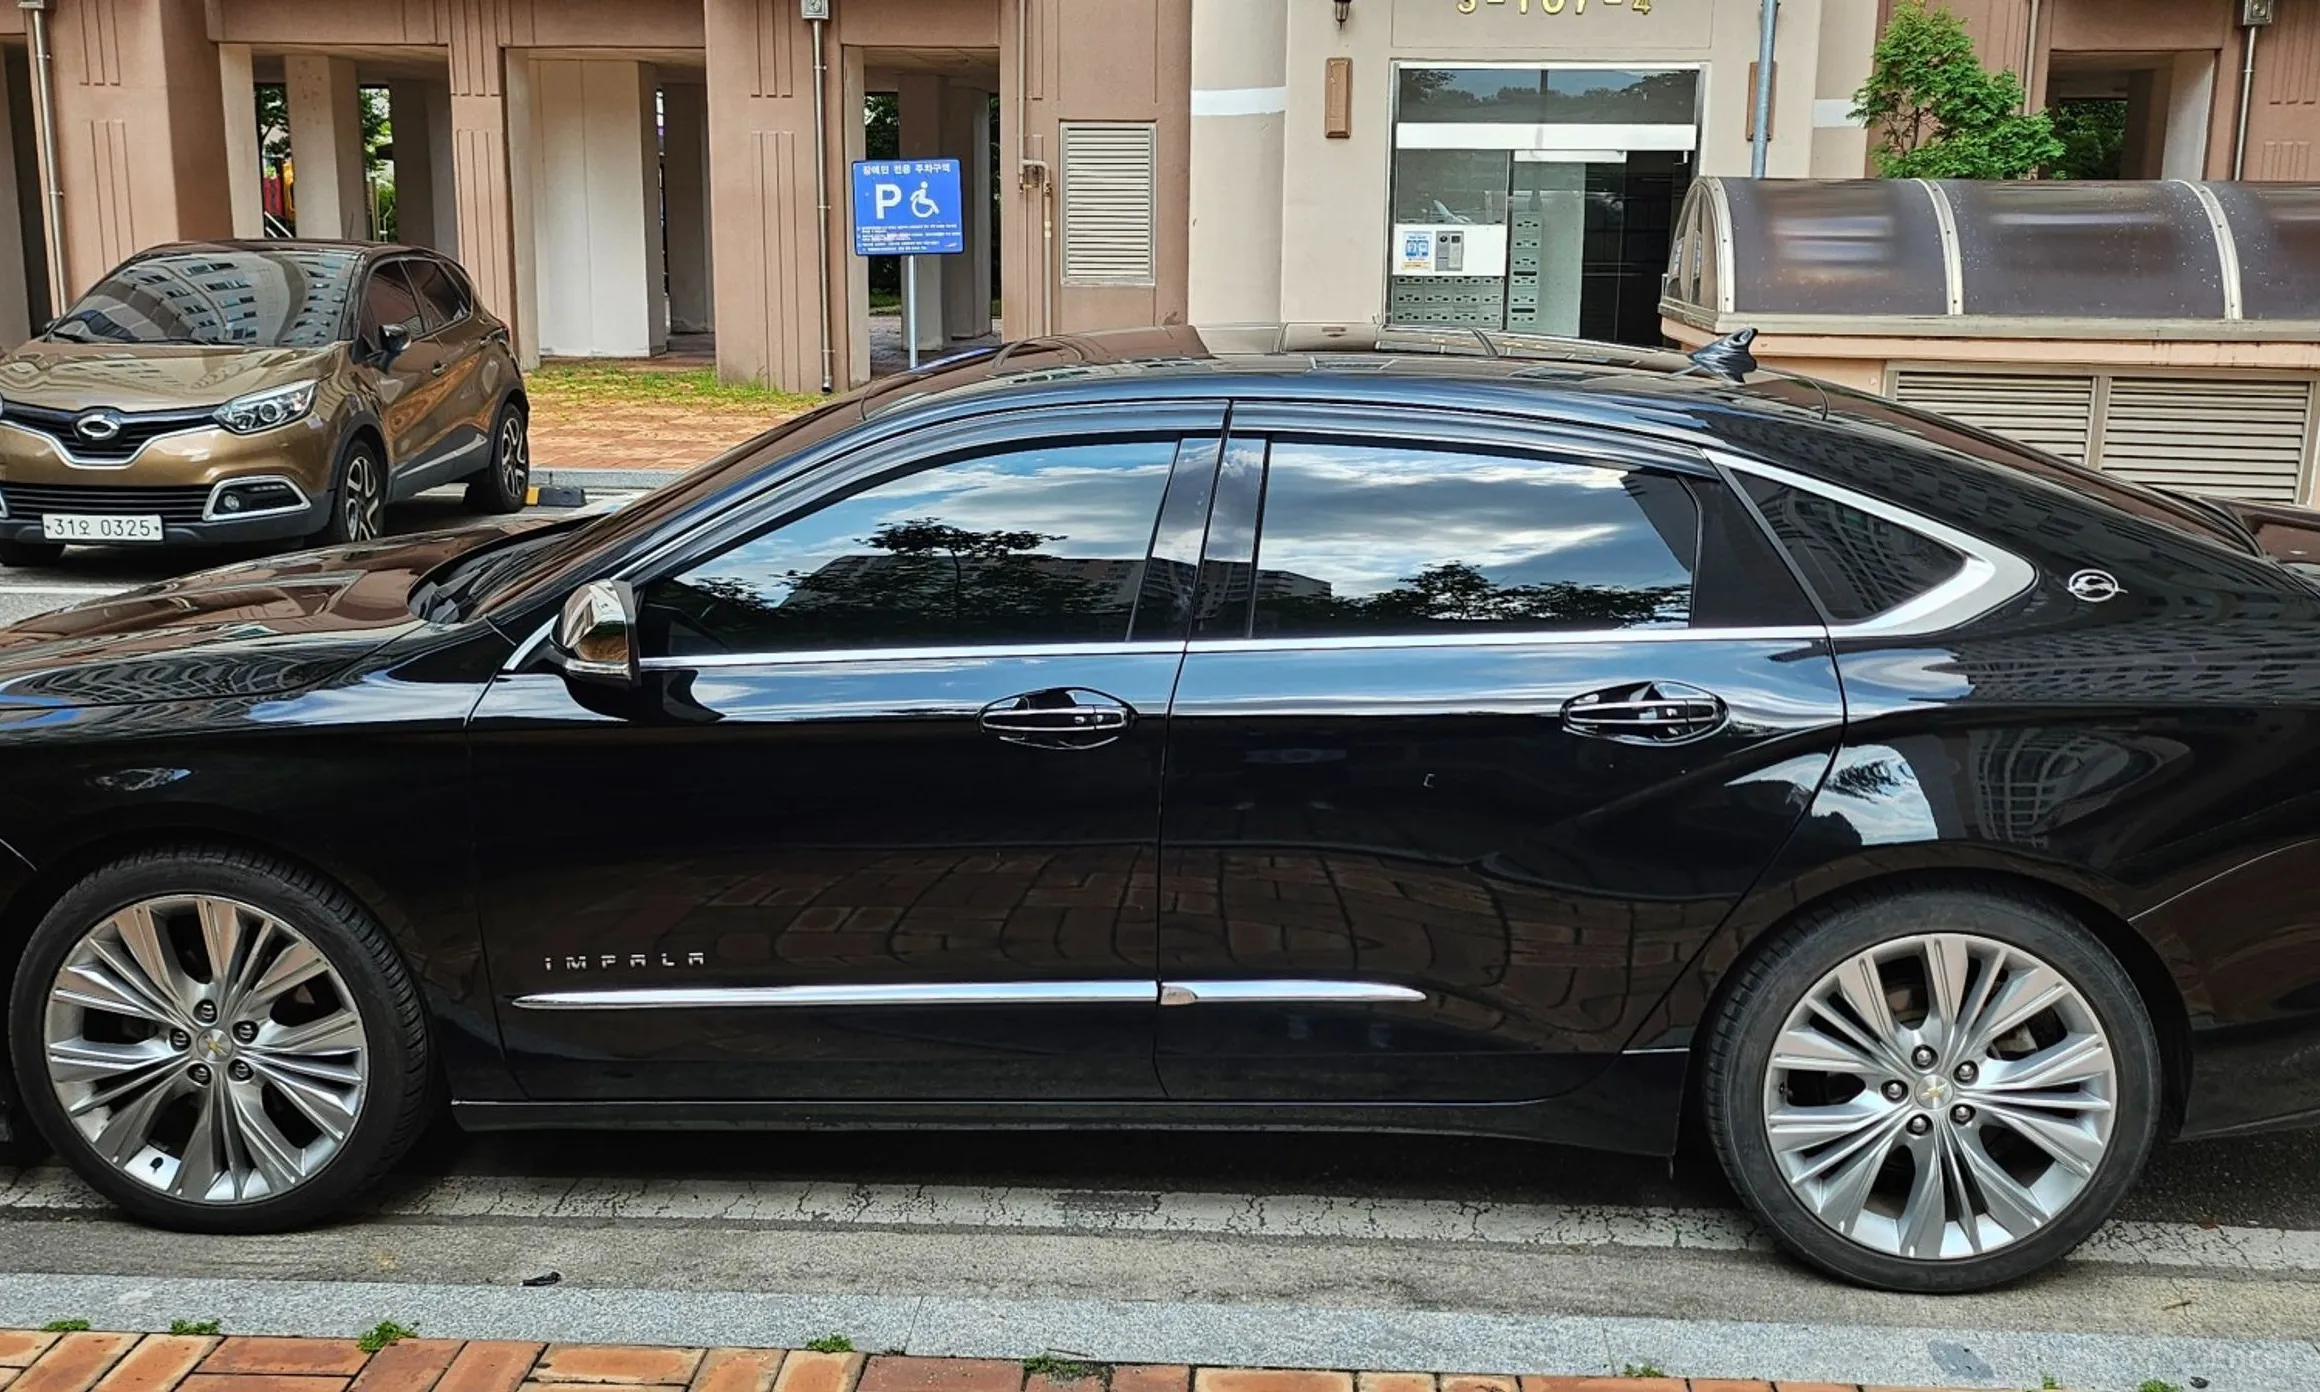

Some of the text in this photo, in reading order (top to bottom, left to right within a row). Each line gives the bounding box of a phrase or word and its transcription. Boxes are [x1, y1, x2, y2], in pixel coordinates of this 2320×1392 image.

[875, 183, 902, 220] P
[53, 518, 151, 537] 31오 0325
[544, 952, 704, 970] IMPALA
